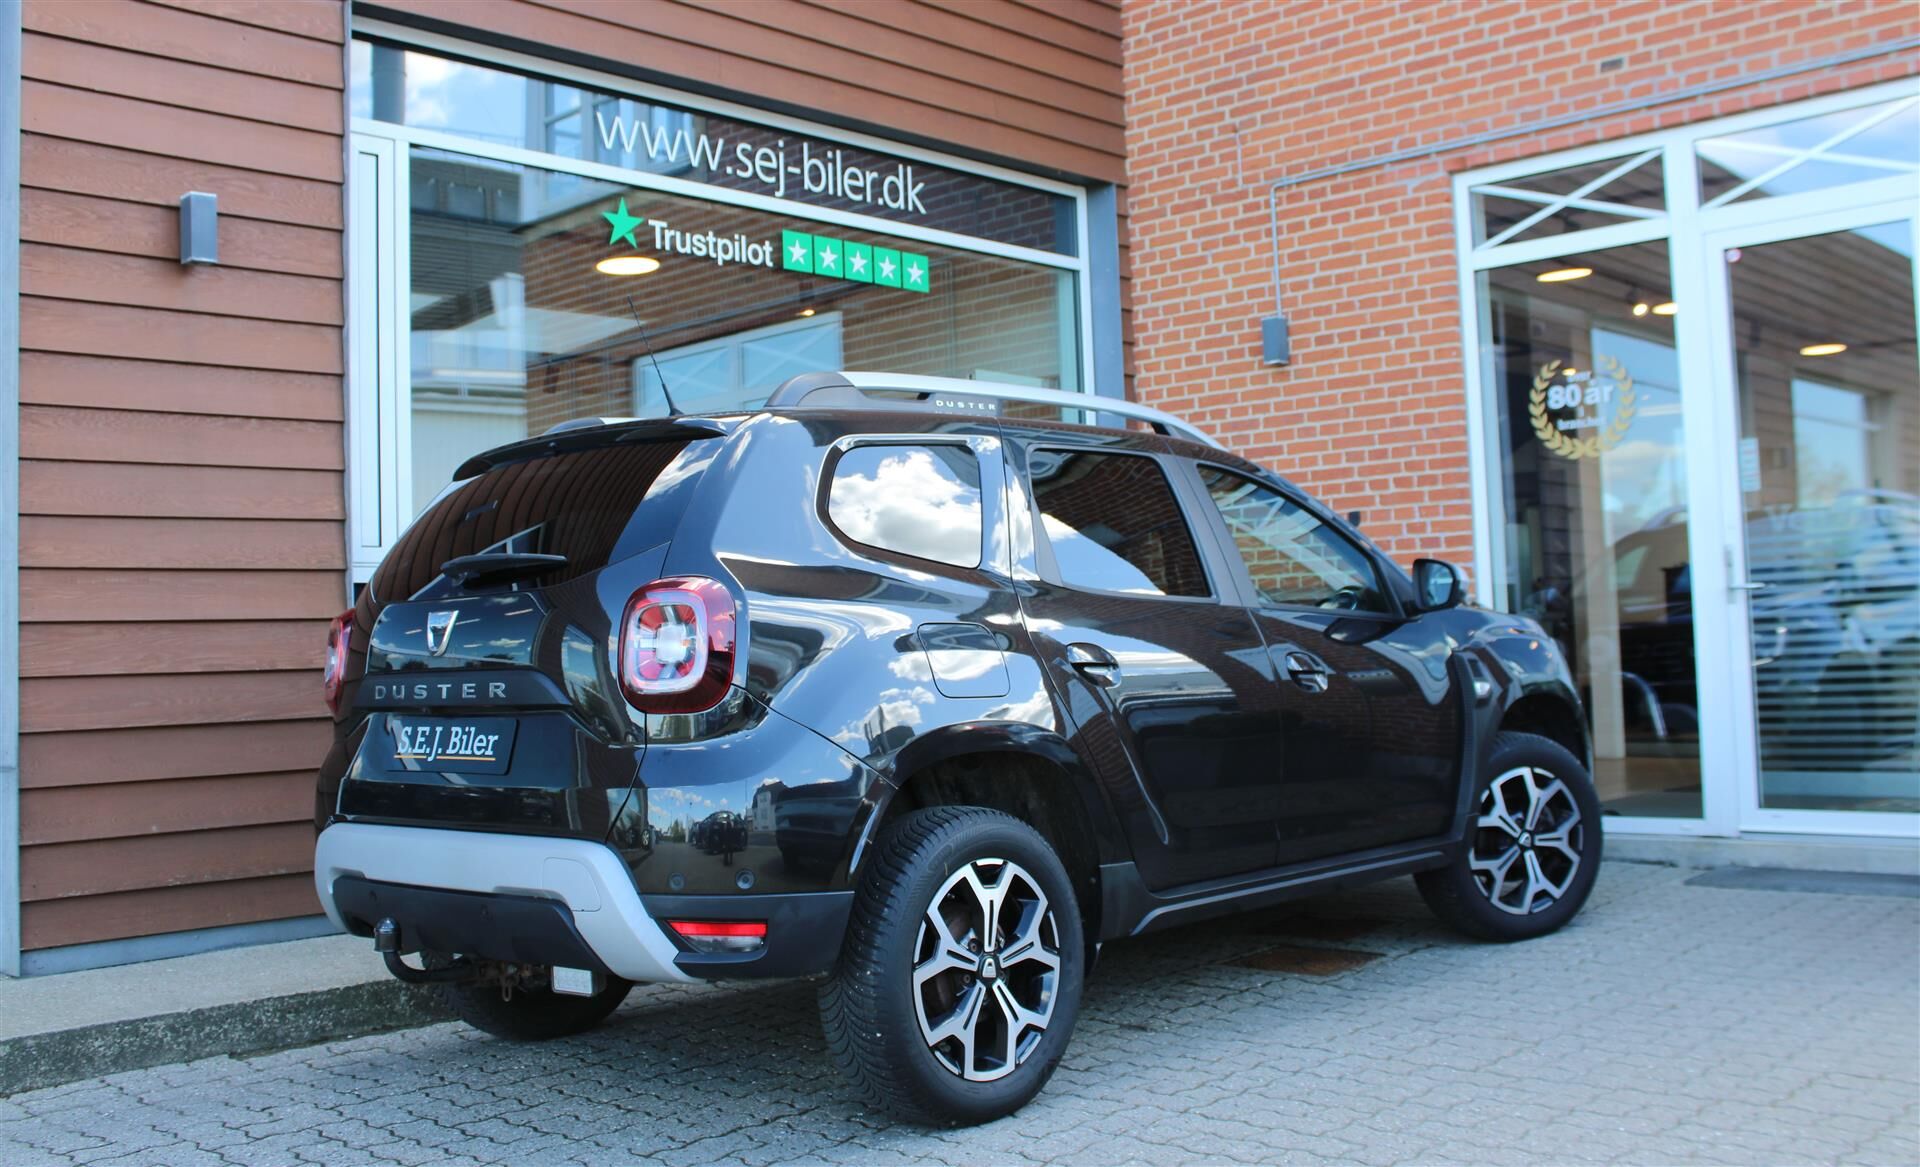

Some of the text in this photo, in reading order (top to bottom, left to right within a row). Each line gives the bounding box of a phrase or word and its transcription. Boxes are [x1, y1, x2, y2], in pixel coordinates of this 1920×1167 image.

[596, 111, 927, 215] www.sej-biler.dk
[648, 219, 774, 268] Trustpilot
[935, 400, 997, 411] DUSTER
[1547, 384, 1581, 409] 80
[374, 682, 507, 700] DUSTER
[397, 725, 499, 762] S.E.J. Biler
